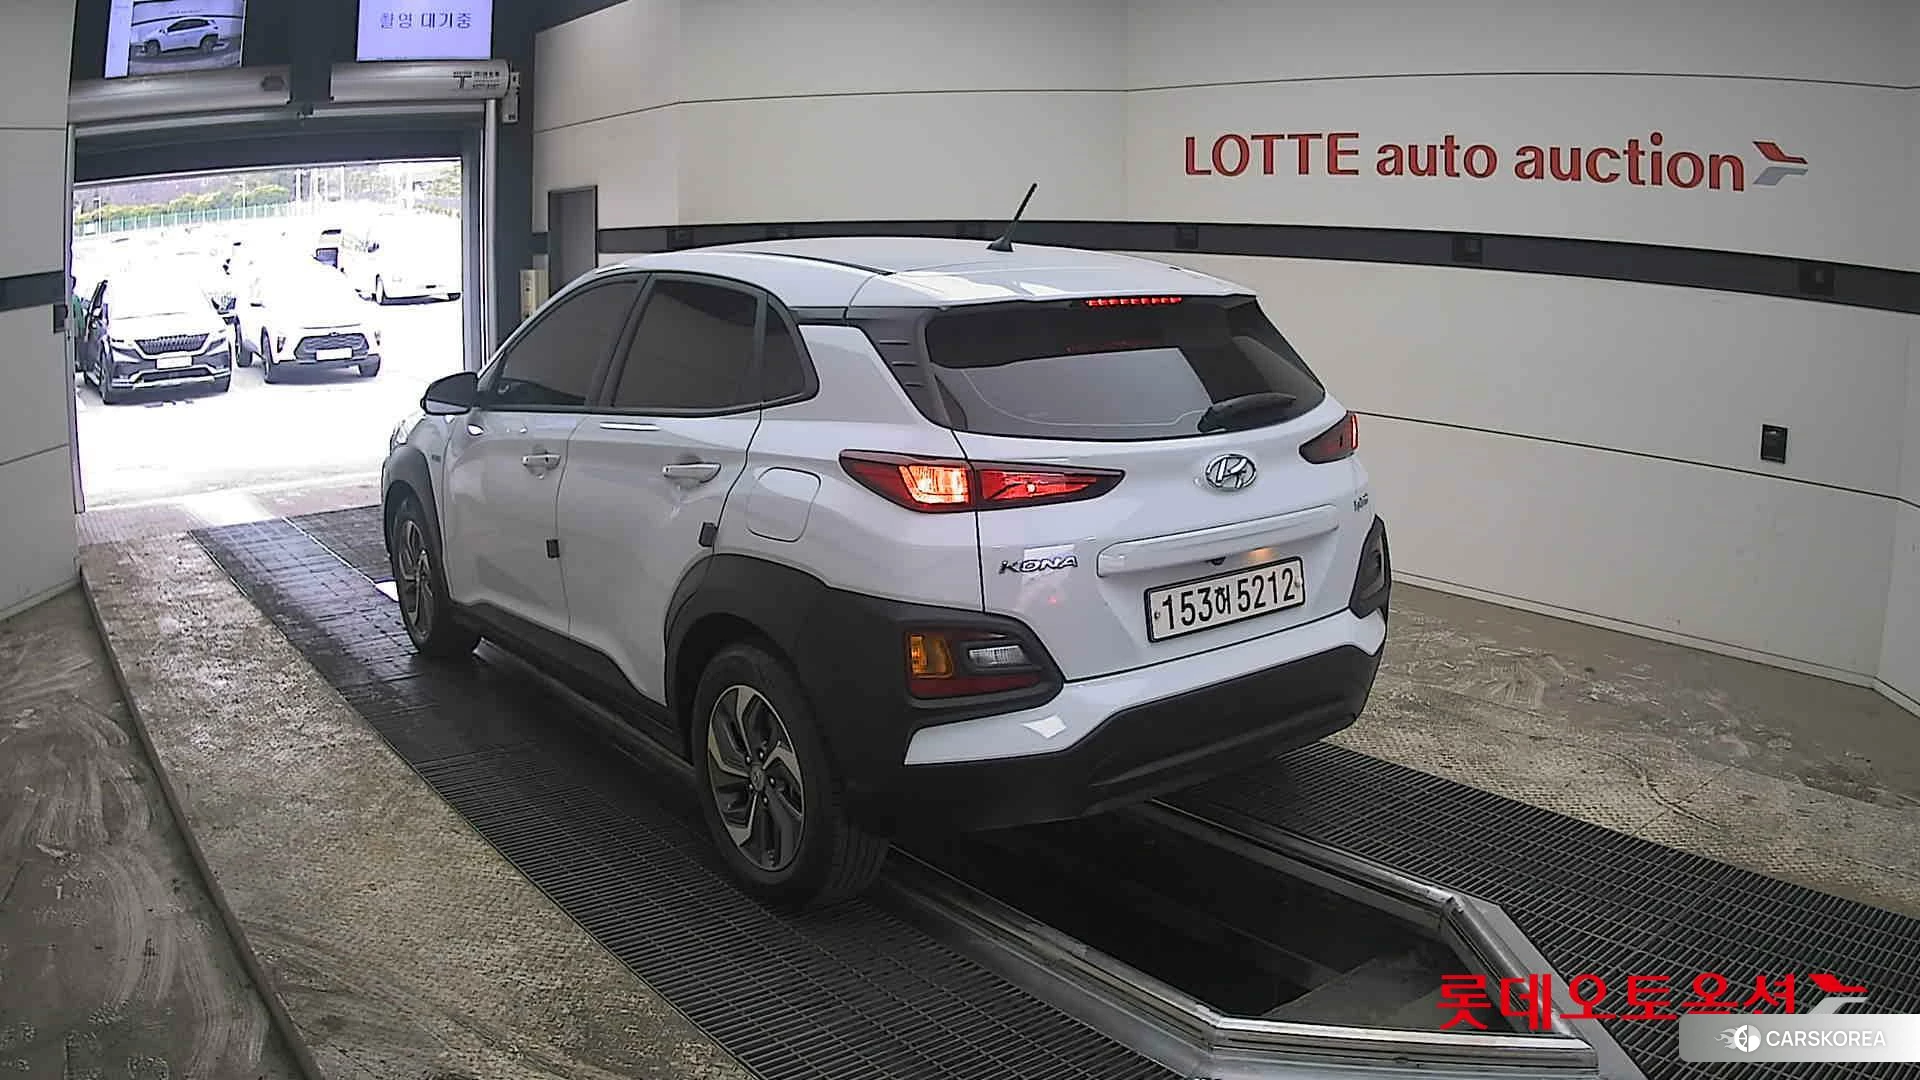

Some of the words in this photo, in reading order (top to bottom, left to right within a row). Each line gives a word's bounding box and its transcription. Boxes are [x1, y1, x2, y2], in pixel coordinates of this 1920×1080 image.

[420, 12, 472, 29] 대기중
[1184, 132, 1360, 177] LOTTE
[1375, 134, 1499, 178] auto
[1514, 131, 1746, 191] auction
[998, 555, 1079, 575] KONA
[1161, 584, 1232, 630] 153허
[1236, 567, 1296, 613] 5212
